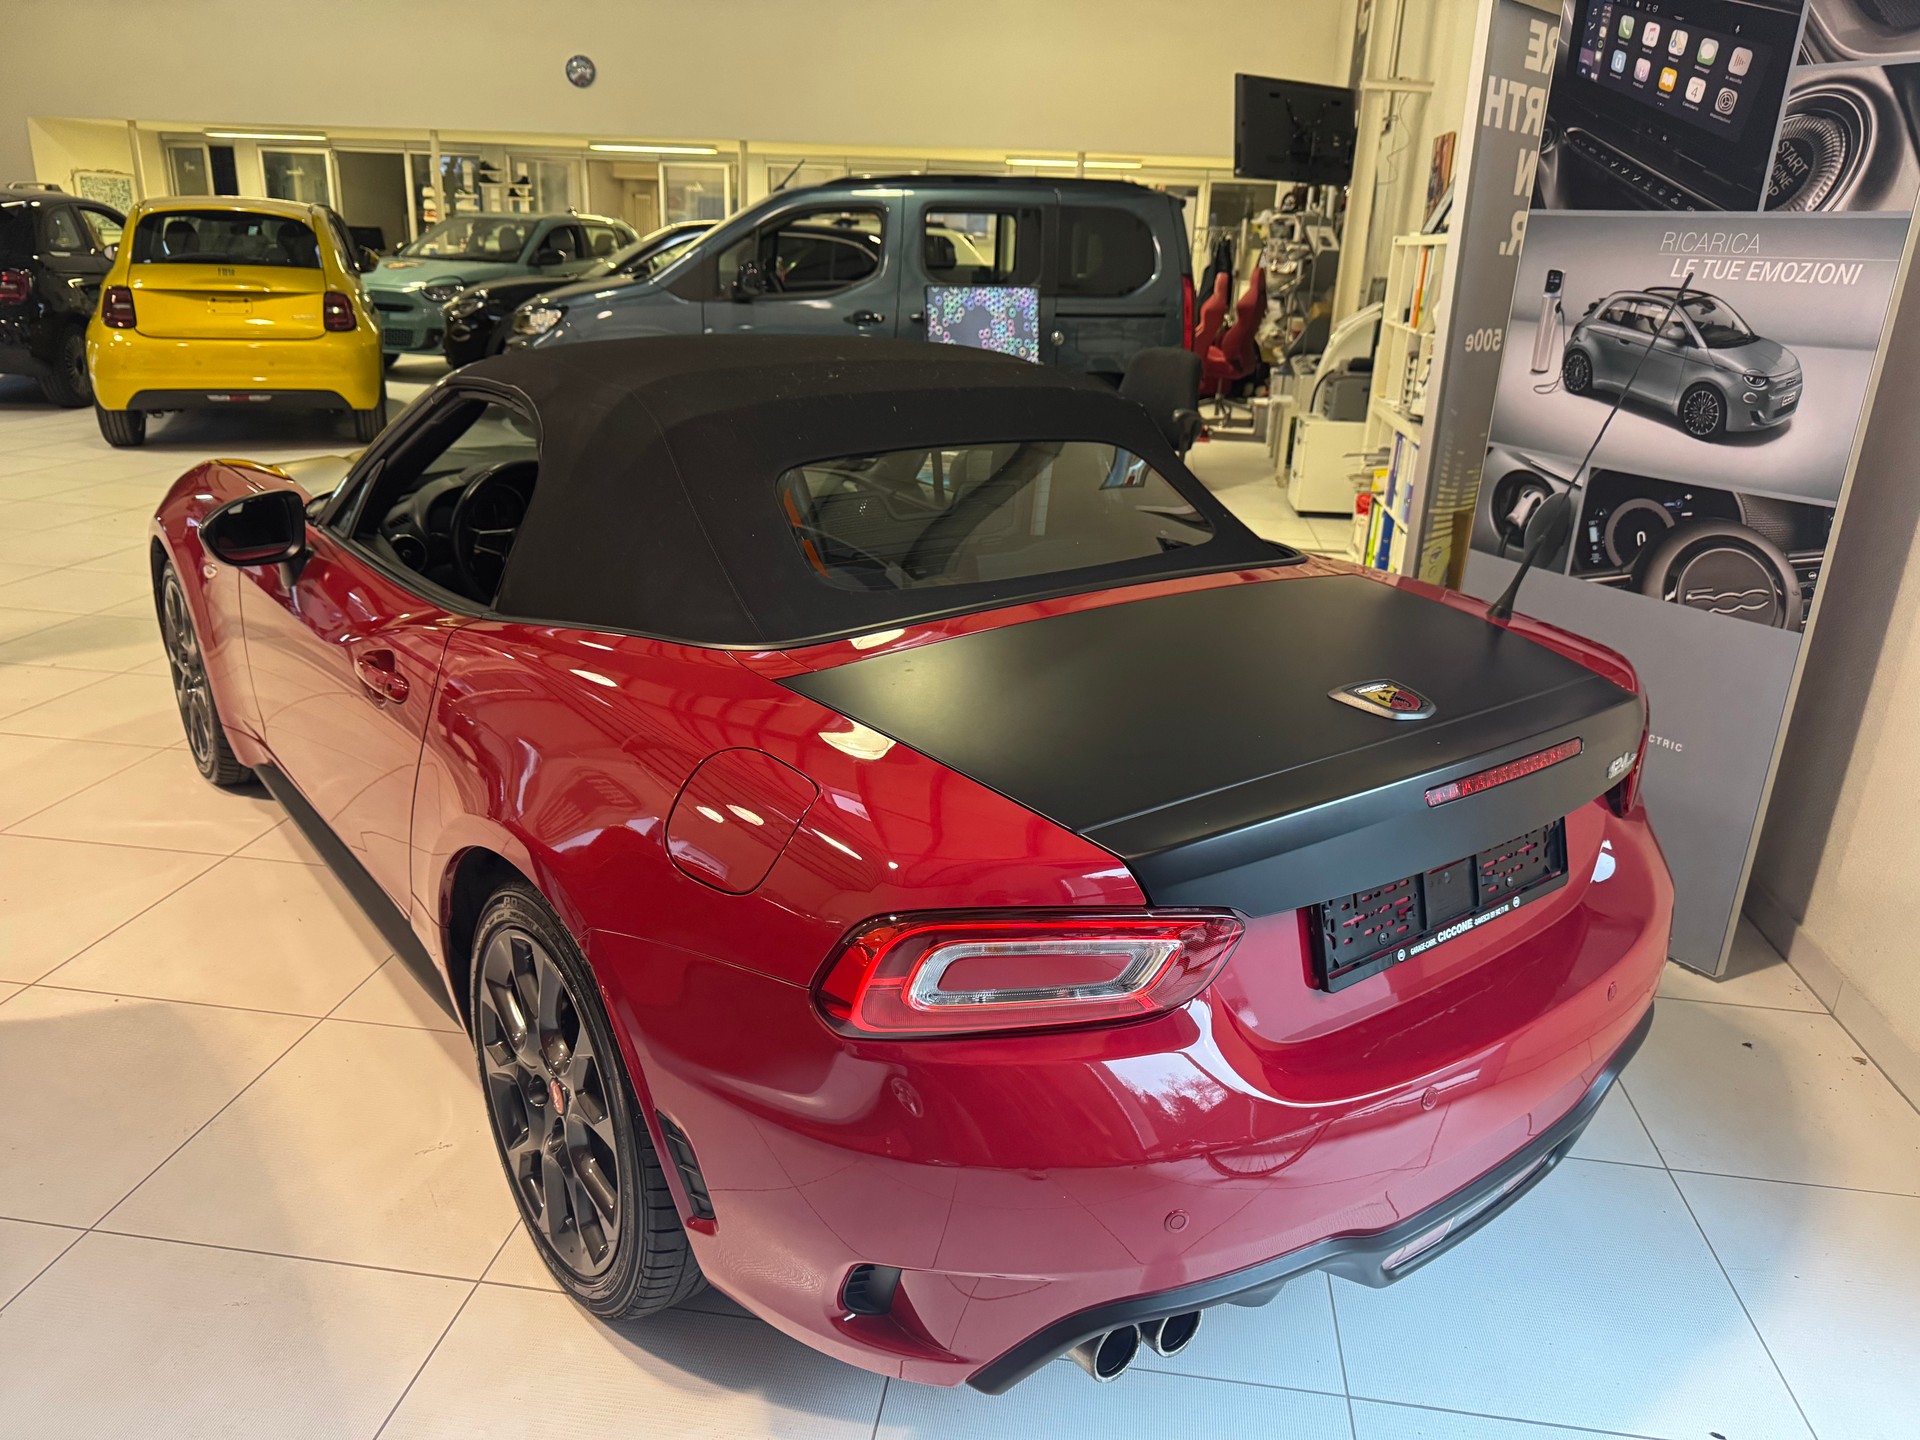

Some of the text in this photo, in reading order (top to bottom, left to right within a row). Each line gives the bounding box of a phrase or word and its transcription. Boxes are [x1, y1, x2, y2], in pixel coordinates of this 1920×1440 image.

[1777, 140, 1809, 177] START
[1659, 231, 1760, 254] RICARICA
[1670, 257, 1864, 286] LE TUE EMOZIONI
[1647, 733, 1684, 753] CTRIC
[1437, 918, 1473, 942] CICCONE
